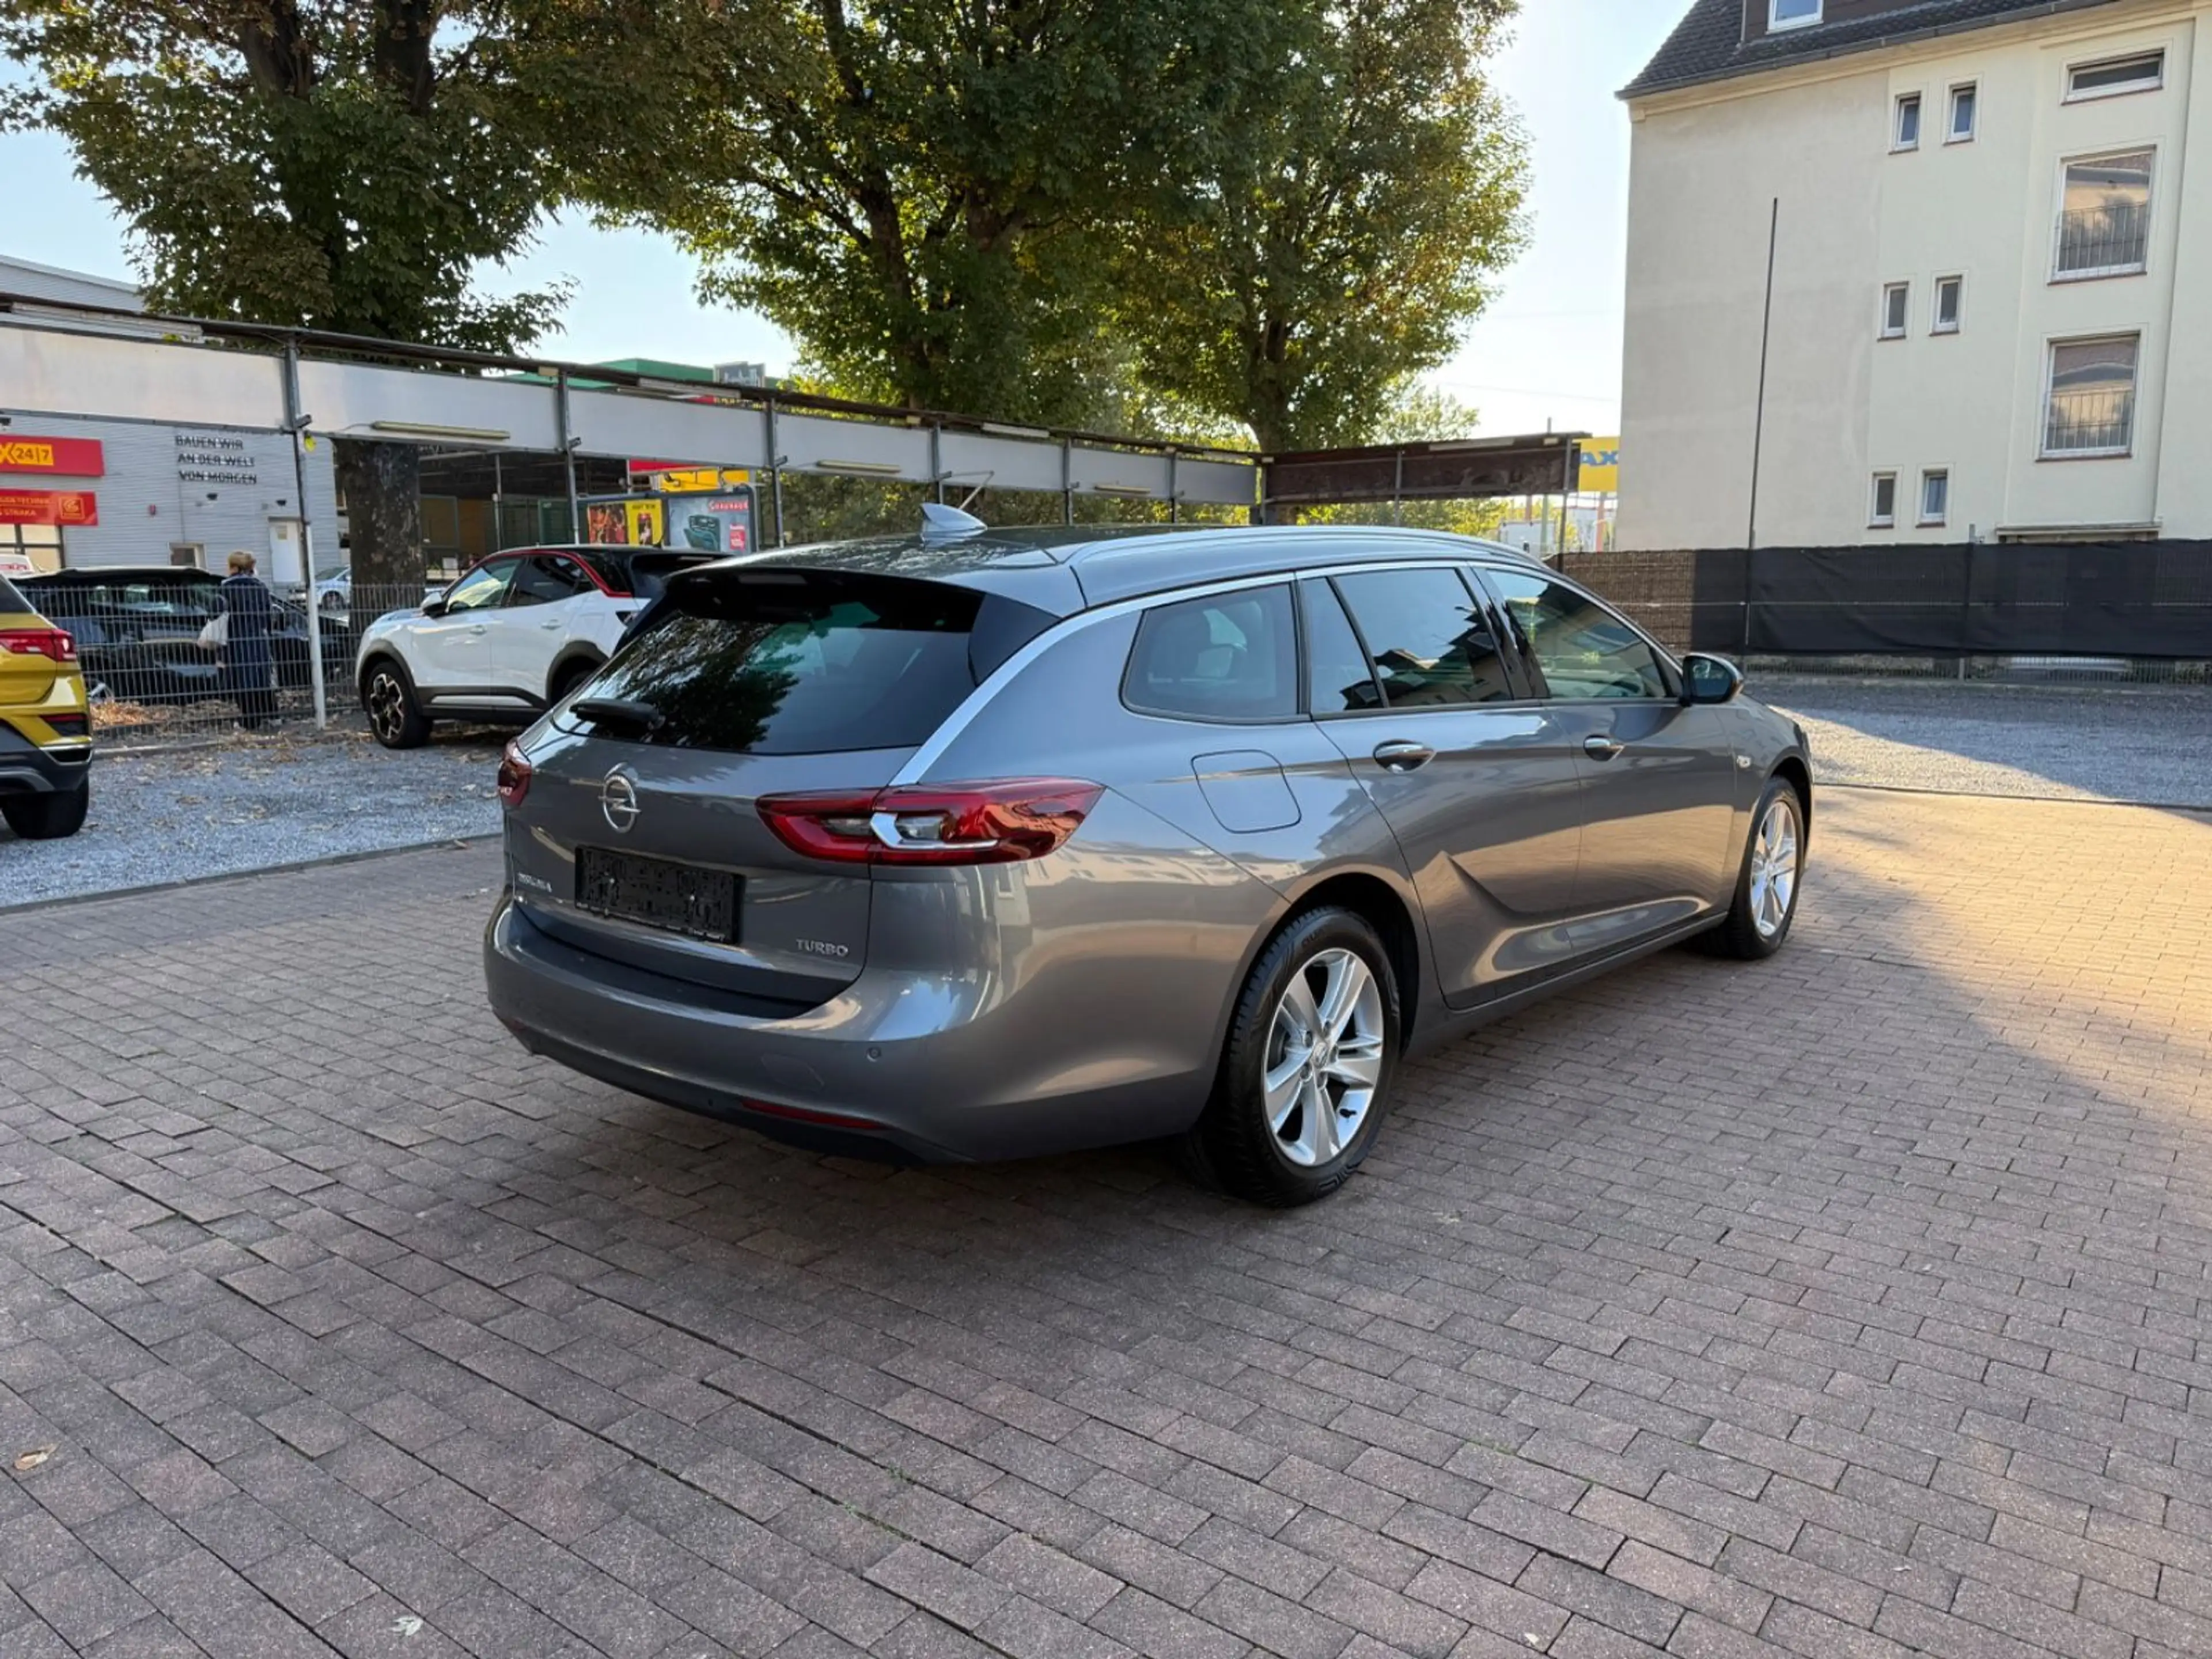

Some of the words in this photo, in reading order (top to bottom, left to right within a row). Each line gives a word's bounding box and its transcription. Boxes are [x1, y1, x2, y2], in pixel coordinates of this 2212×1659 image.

[175, 435, 217, 448] BAUEN
[218, 438, 243, 449] WIR
[178, 453, 195, 463] AN
[198, 454, 221, 466] DER
[224, 456, 255, 467] WELT
[179, 470, 204, 480] VON
[207, 472, 257, 484] MORGEN
[796, 938, 849, 957] TURBO
